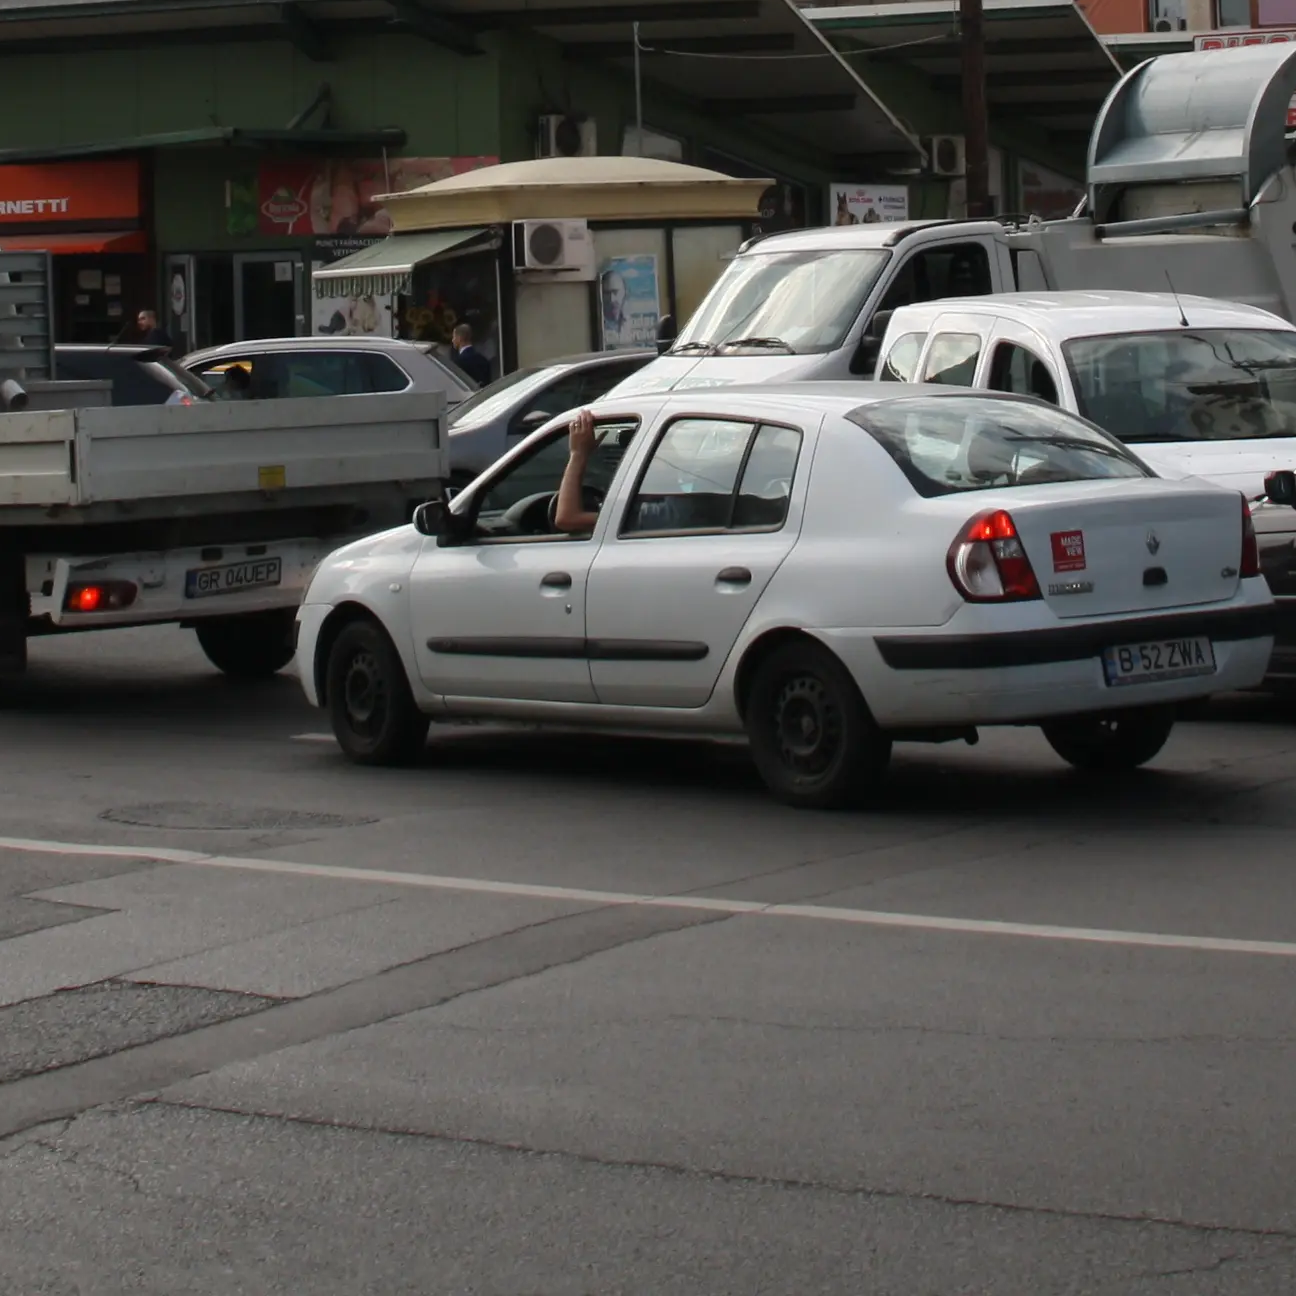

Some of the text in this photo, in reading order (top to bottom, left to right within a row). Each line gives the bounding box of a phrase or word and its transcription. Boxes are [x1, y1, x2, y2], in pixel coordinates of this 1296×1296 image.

[198, 571, 220, 590] GR
[1119, 640, 1205, 673] B 52 ZWA
